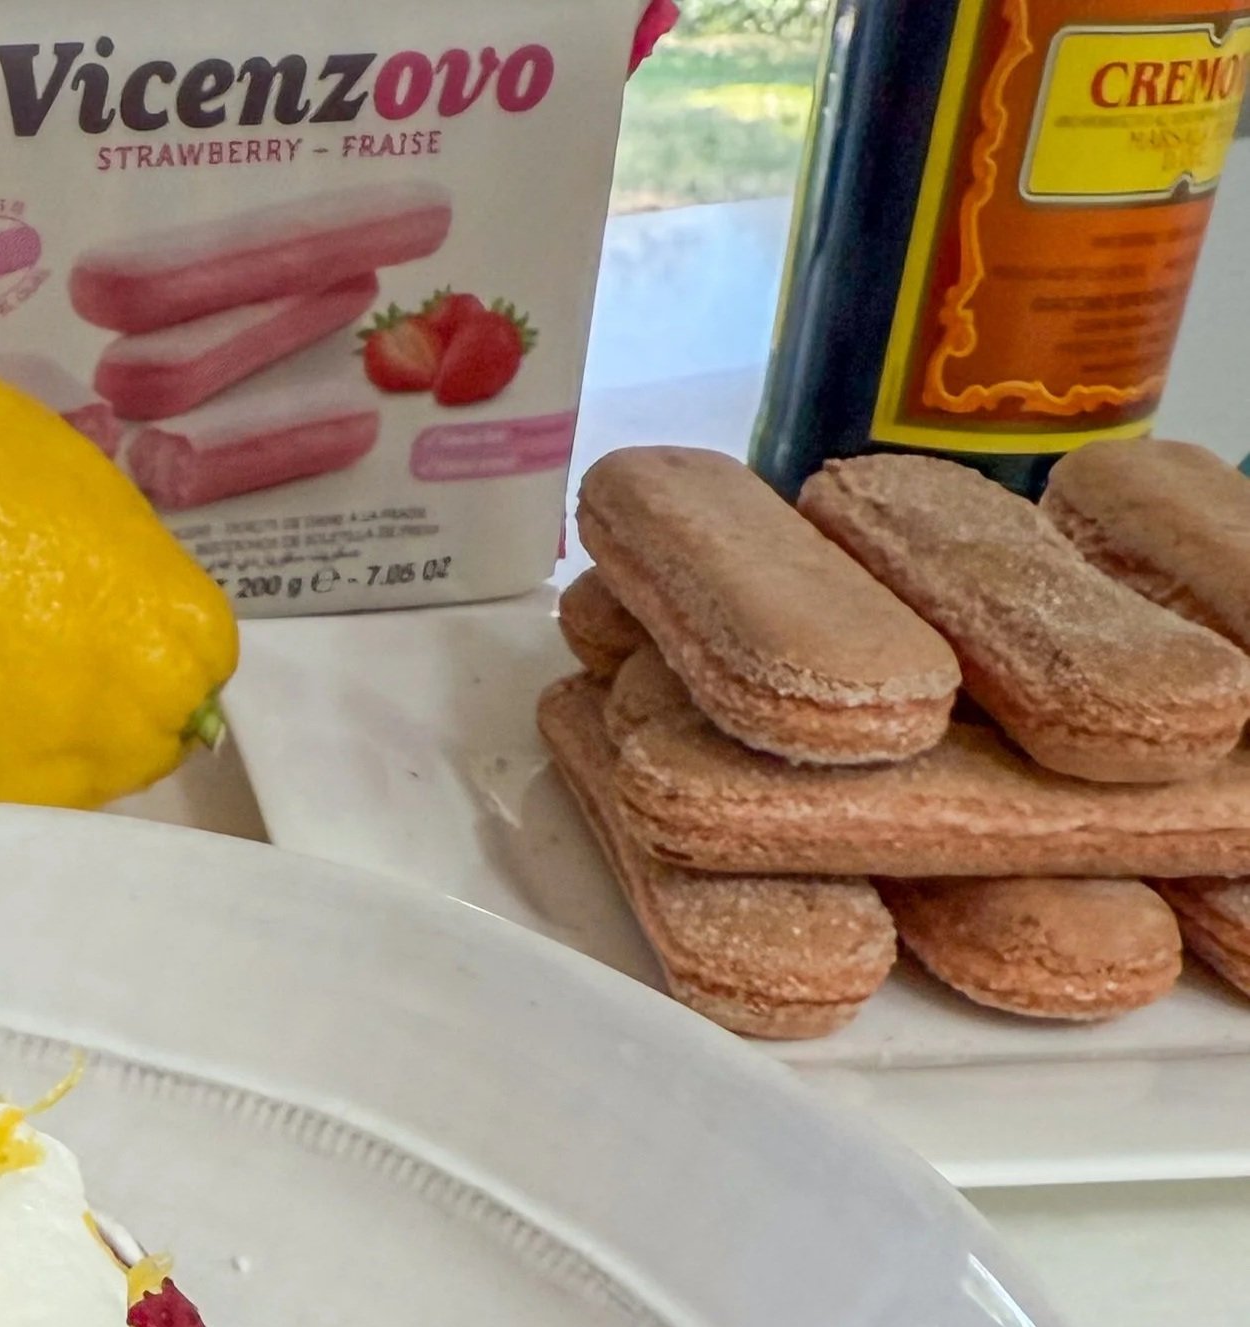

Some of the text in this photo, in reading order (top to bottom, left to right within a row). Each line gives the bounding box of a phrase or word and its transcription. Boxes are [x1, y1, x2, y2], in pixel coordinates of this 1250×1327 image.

[97, 139, 303, 170] STRAWBERRY
[341, 130, 442, 157] FRAISE
[236, 575, 282, 599] 200
